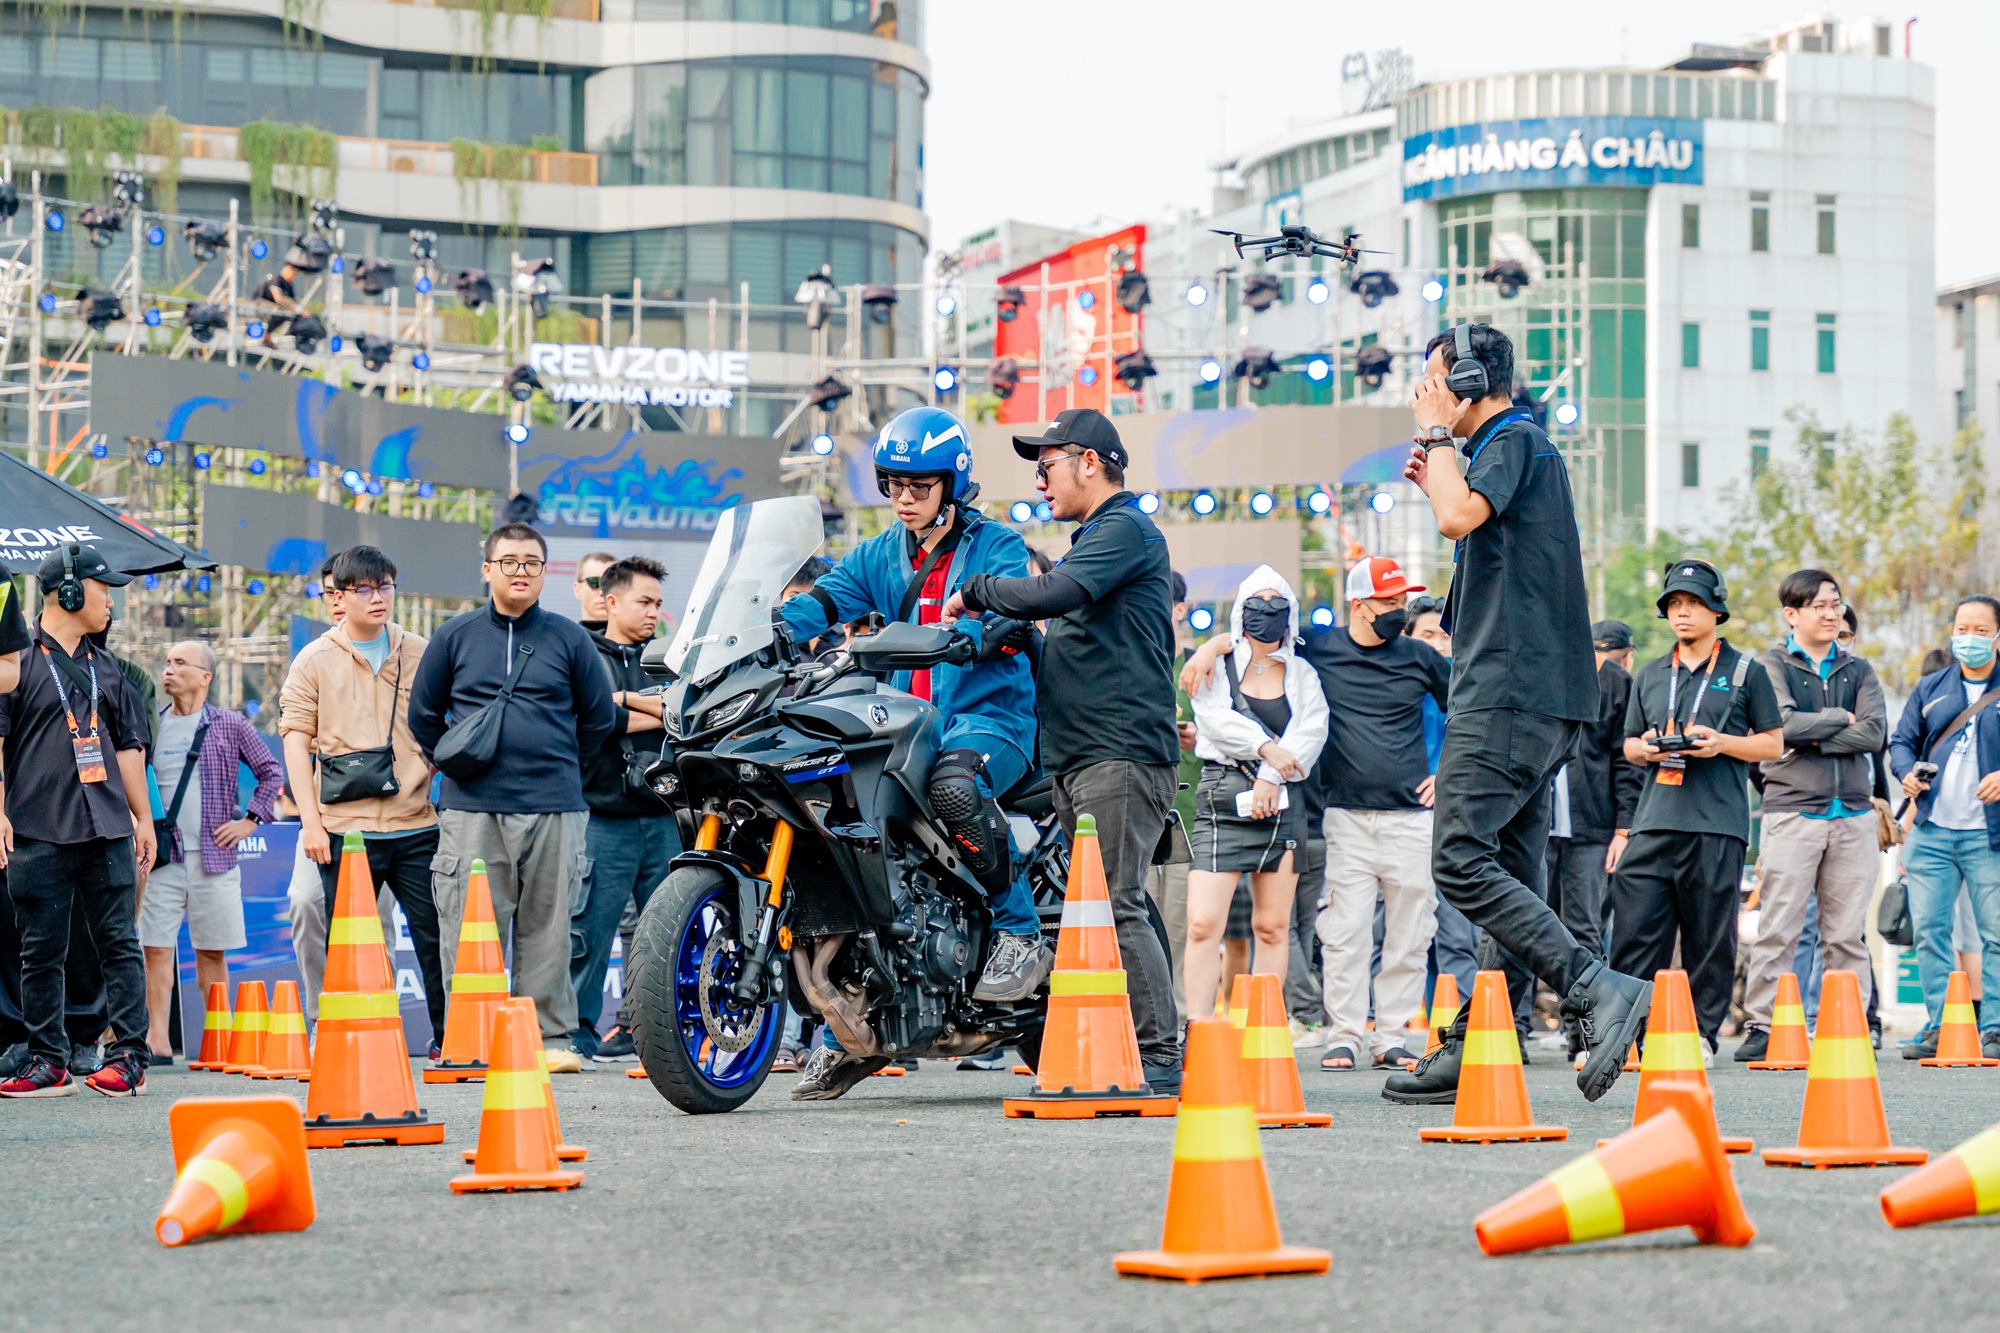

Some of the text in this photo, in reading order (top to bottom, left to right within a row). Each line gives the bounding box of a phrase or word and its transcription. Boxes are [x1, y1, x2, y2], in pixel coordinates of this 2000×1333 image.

[1459, 133, 1558, 177] HÀNG
[1559, 129, 1589, 168] Á
[1591, 130, 1693, 170] CHÂU
[530, 342, 750, 385] REVZONE
[551, 382, 733, 408] YAMAHA MOTOR
[890, 454, 911, 463] YAMAHA
[50, 664, 66, 701] ORGANIZER
[89, 666, 98, 700] ORGANIZER
[782, 753, 844, 771] TRACER 9
[817, 766, 837, 775] GT
[238, 836, 268, 852] AHA
